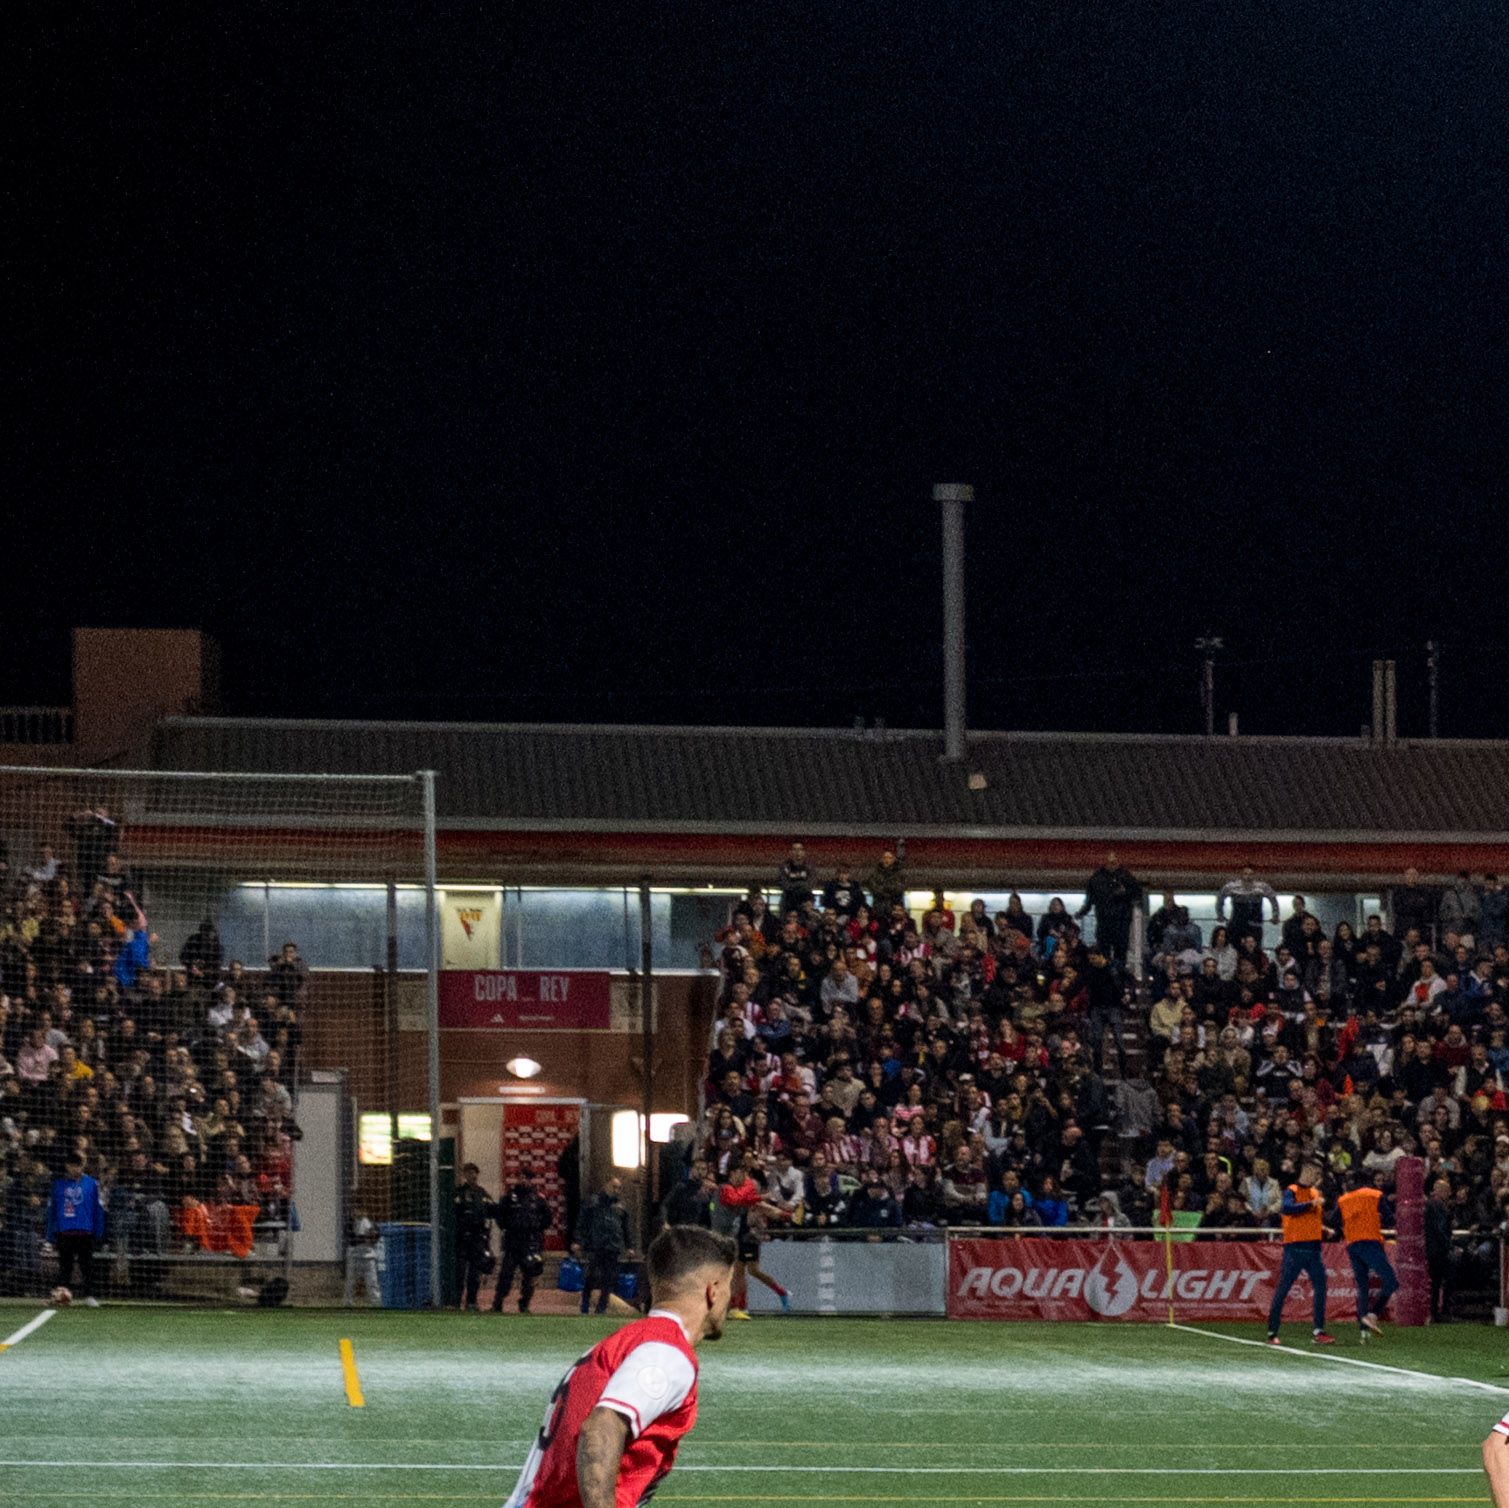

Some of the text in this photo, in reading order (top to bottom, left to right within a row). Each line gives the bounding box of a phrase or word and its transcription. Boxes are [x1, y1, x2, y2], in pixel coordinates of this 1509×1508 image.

[475, 974, 569, 1001] COPA REY
[956, 1266, 1086, 1299] AQUA
[1141, 1268, 1272, 1300] LIGHT
